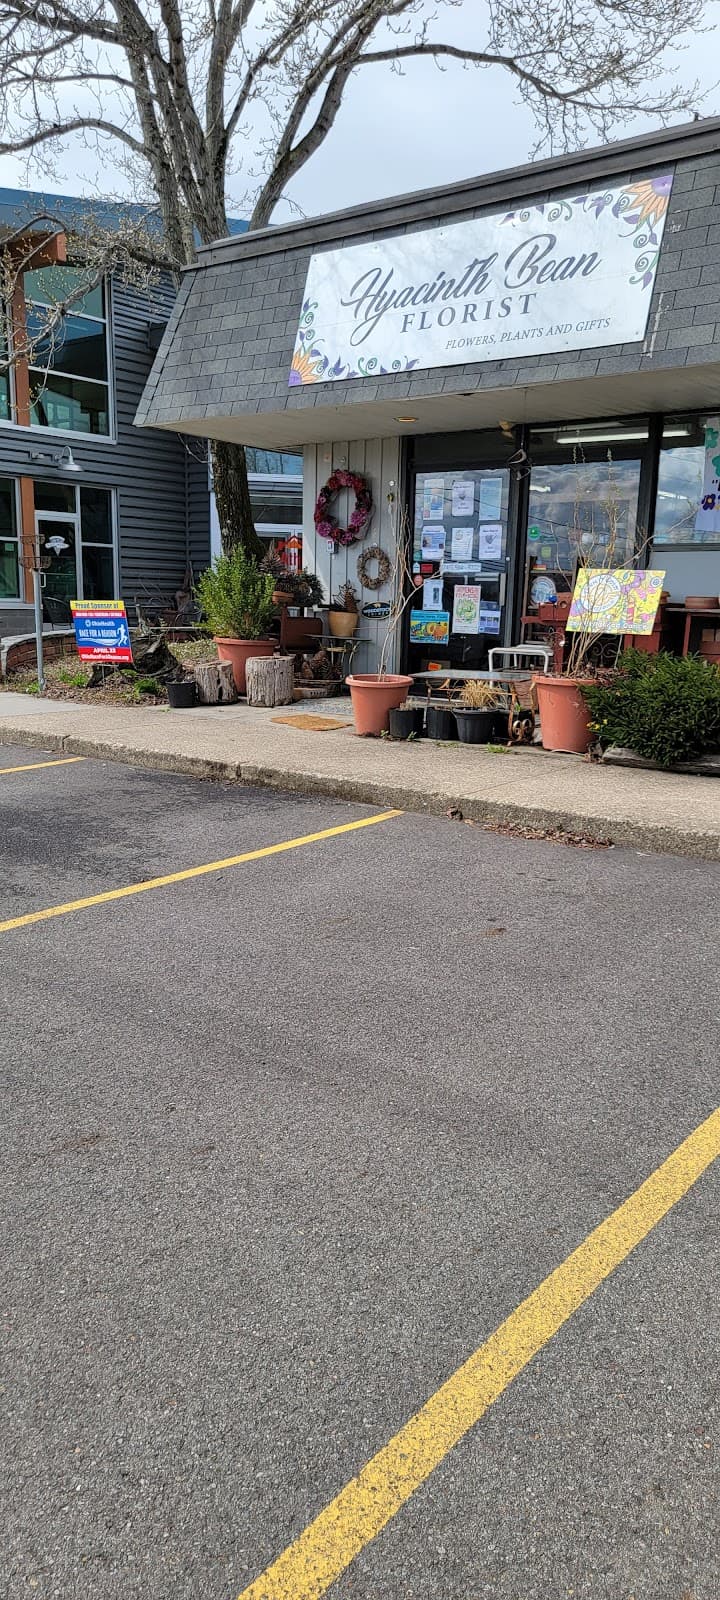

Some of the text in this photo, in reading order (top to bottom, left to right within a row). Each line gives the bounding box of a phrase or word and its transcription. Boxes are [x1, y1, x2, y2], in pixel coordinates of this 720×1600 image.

[341, 233, 602, 346] Hyacinth Bean
[400, 294, 537, 334] FLORIST
[445, 318, 611, 350] FLOWERS, PLANTS AND GIFTS
